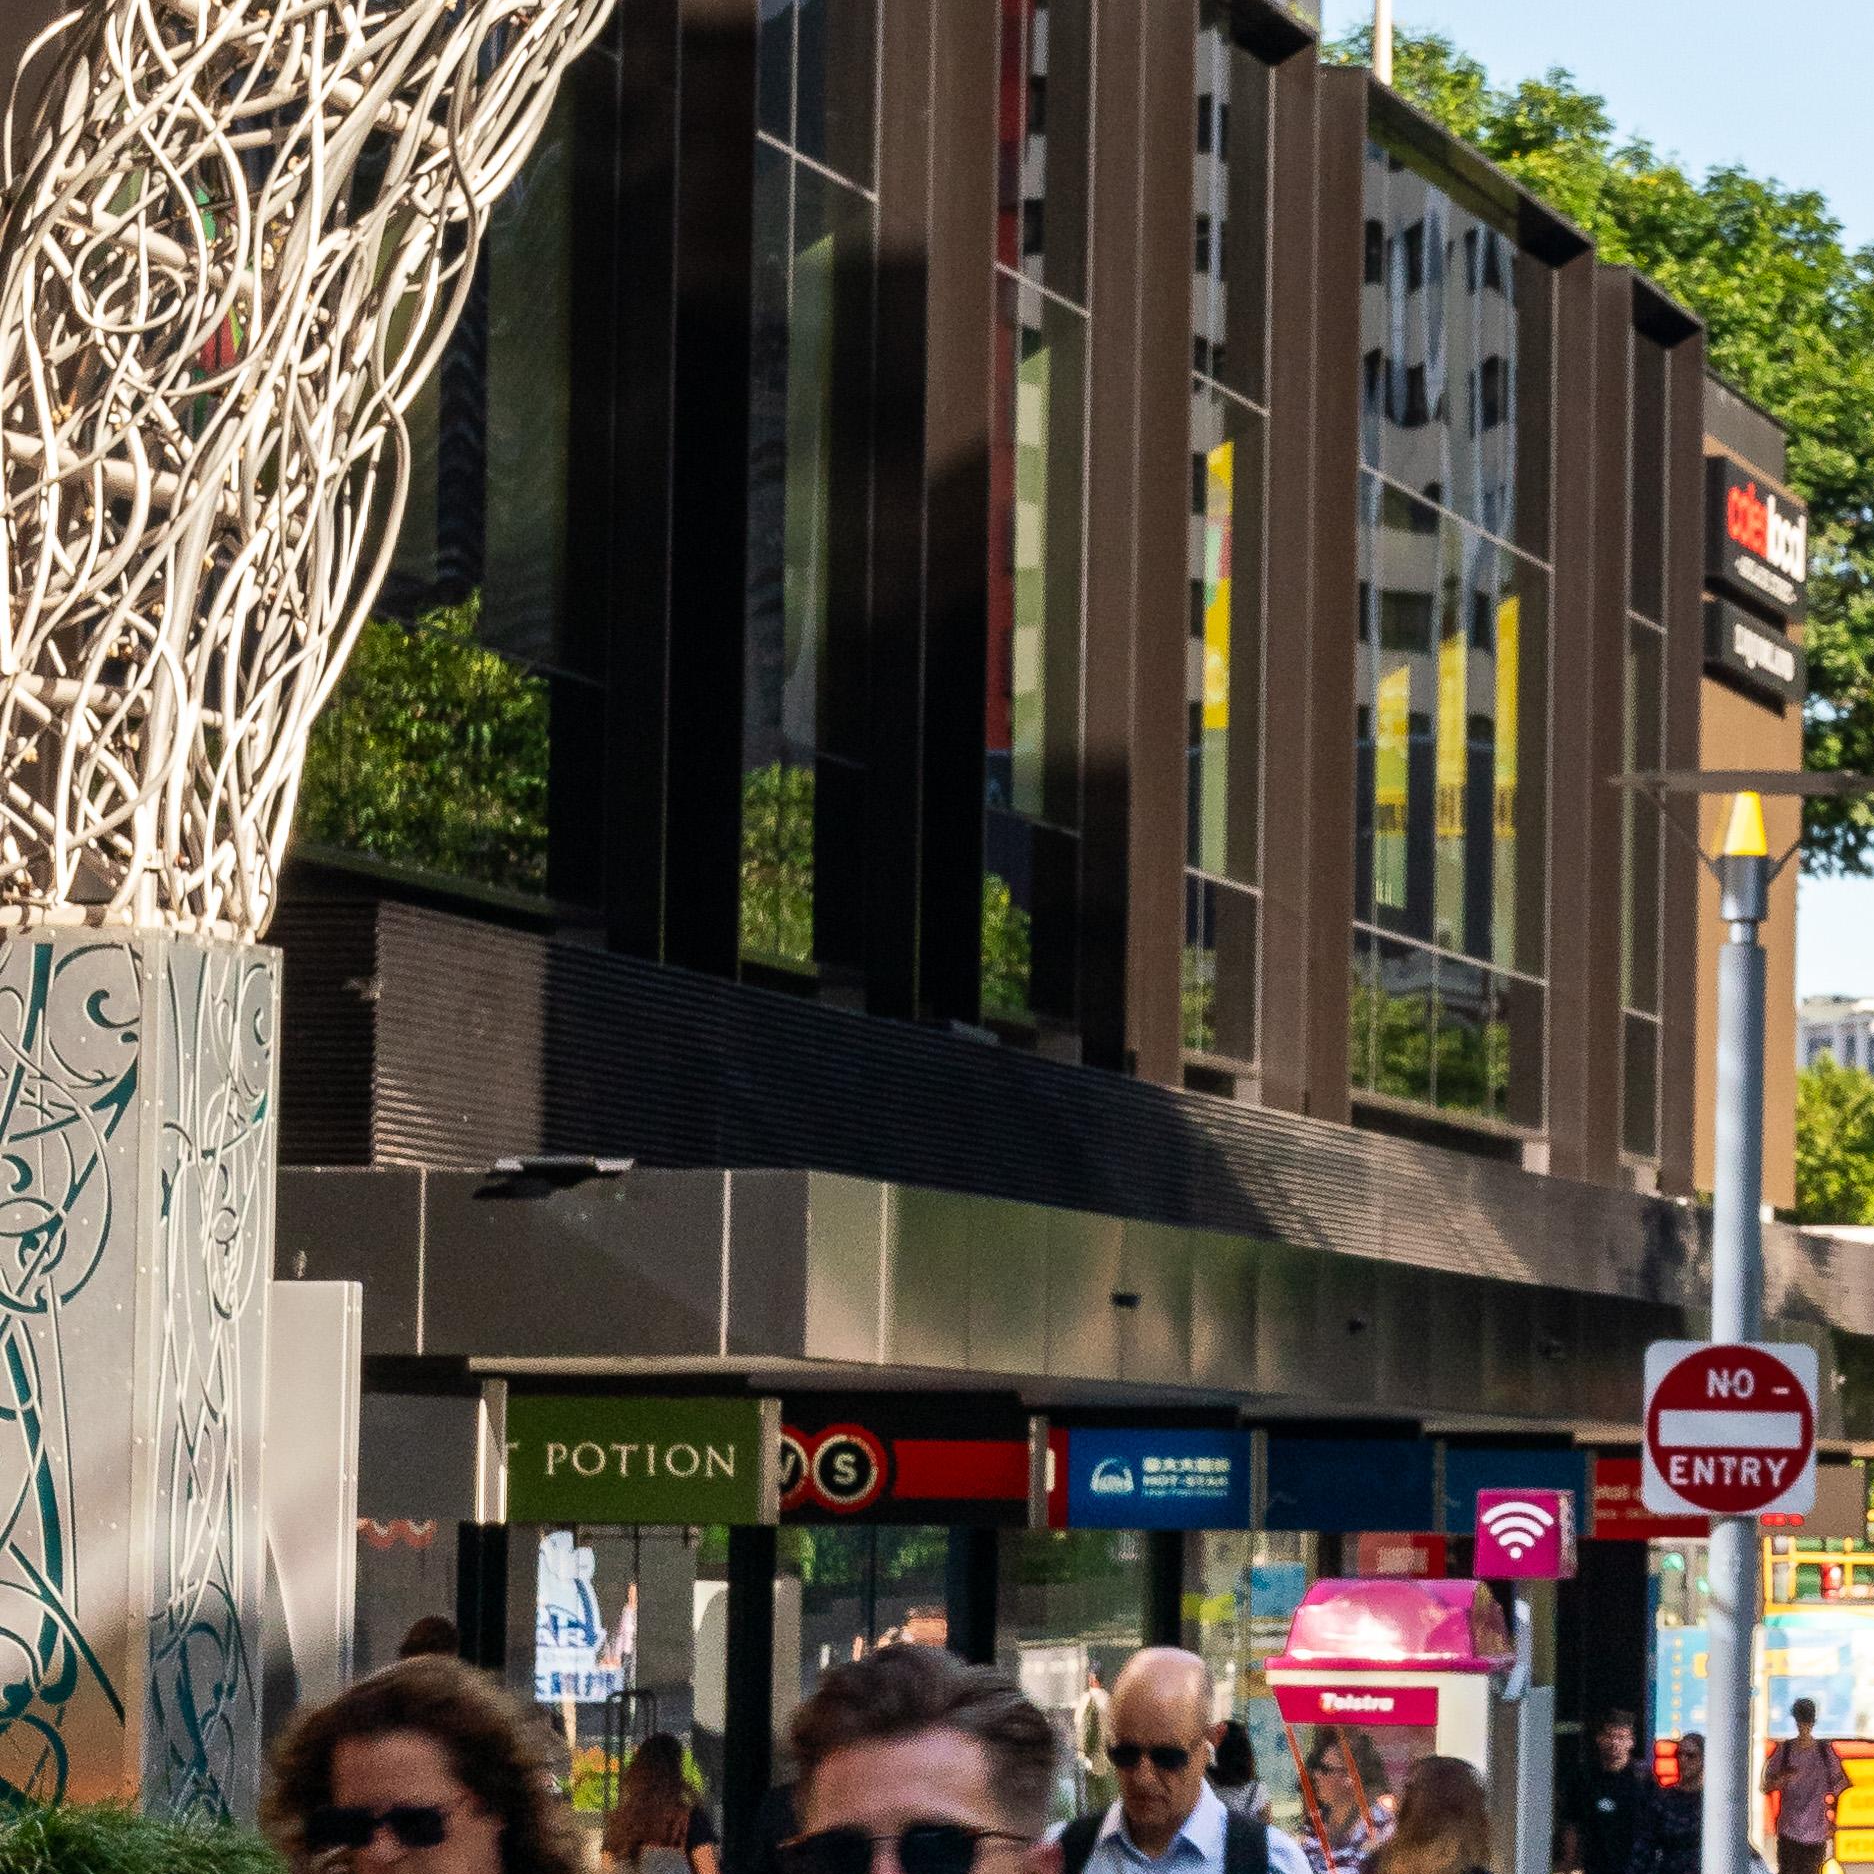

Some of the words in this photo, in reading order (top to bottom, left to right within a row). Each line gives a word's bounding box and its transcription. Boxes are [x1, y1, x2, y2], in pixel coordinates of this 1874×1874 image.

[1706, 1368, 1755, 1399] NO
[546, 1441, 736, 1477] POTION
[1669, 1454, 1788, 1487] ENTRY
[1320, 1691, 1395, 1713] Telstra
